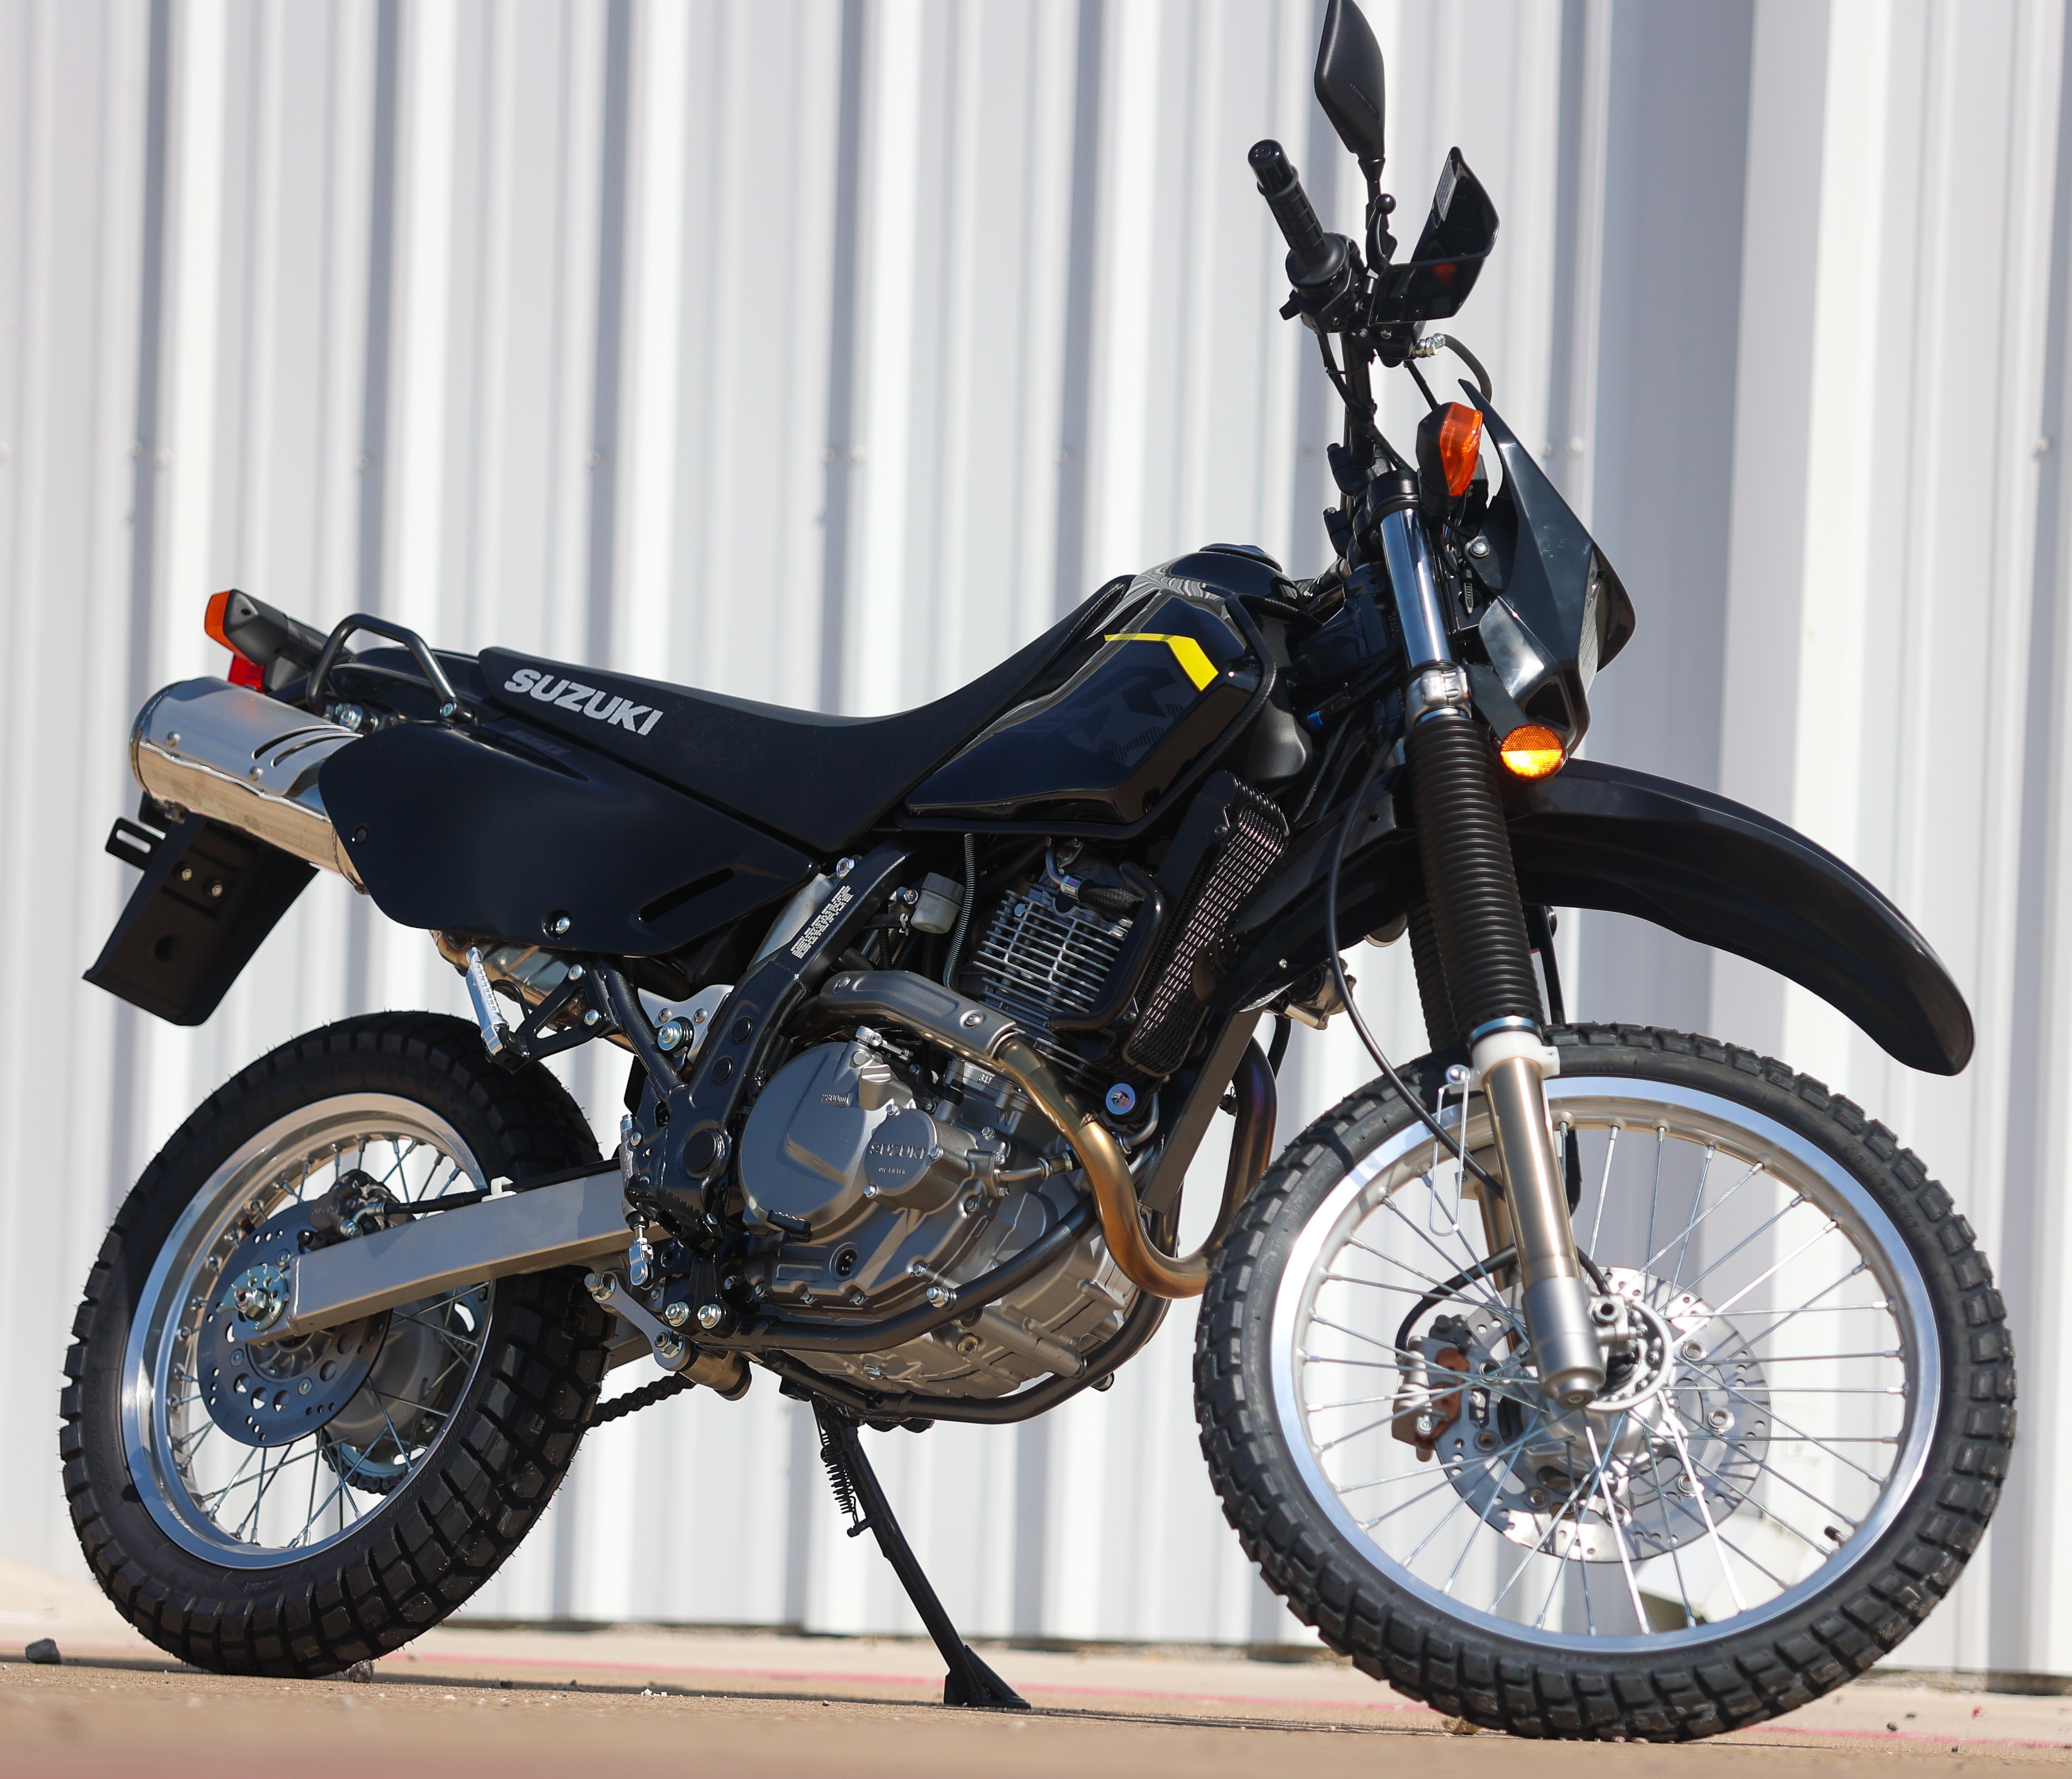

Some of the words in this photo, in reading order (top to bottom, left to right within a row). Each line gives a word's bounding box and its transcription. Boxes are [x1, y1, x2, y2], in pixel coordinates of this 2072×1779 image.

[504, 668, 663, 736] SUZUKI
[870, 1142, 926, 1159] SUZUKI
[1261, 1238, 1285, 1288] TRAIL
[1286, 1185, 1317, 1226] WING
[1324, 1158, 1342, 1177] 41
[1841, 1144, 1926, 1240] BRIDGESTONE
